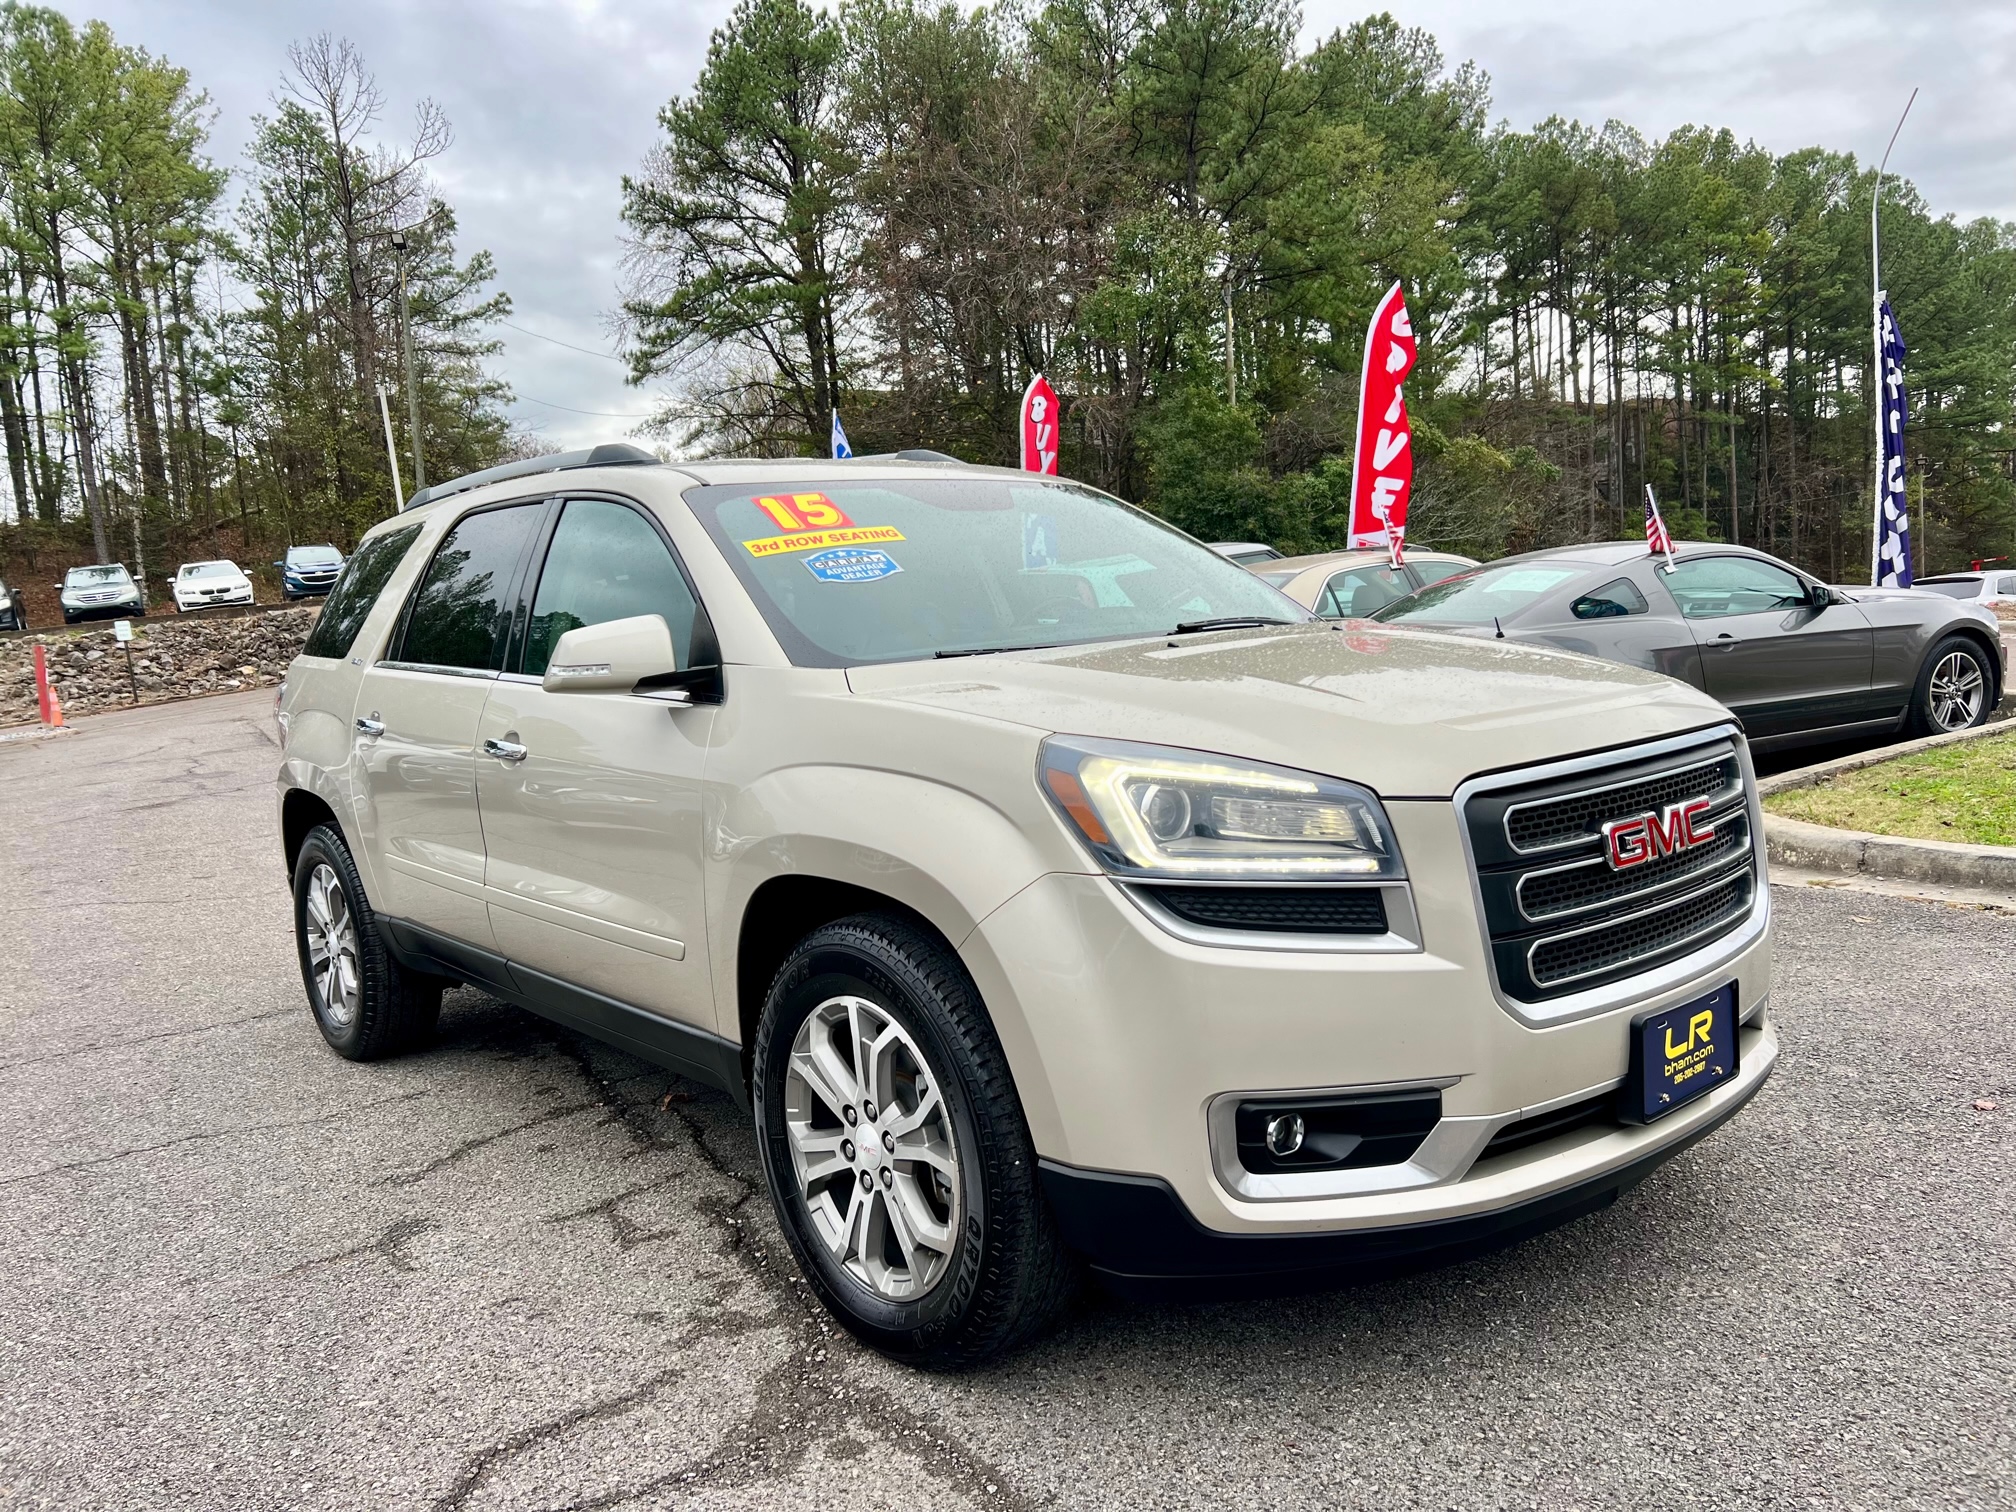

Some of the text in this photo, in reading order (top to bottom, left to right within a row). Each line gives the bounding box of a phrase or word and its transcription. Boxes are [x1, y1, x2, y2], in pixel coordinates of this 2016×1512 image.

[1031, 396, 1055, 474] BUY
[760, 493, 843, 530] 15
[751, 528, 899, 554] 3rd ROW SEATING
[814, 554, 887, 569] CARFAX
[825, 562, 888, 576] ADVANTAGE
[841, 569, 883, 580] DEALER
[1601, 795, 1715, 871] GMC
[1664, 1009, 1714, 1060] LR
[1664, 1043, 1715, 1077] bham.com
